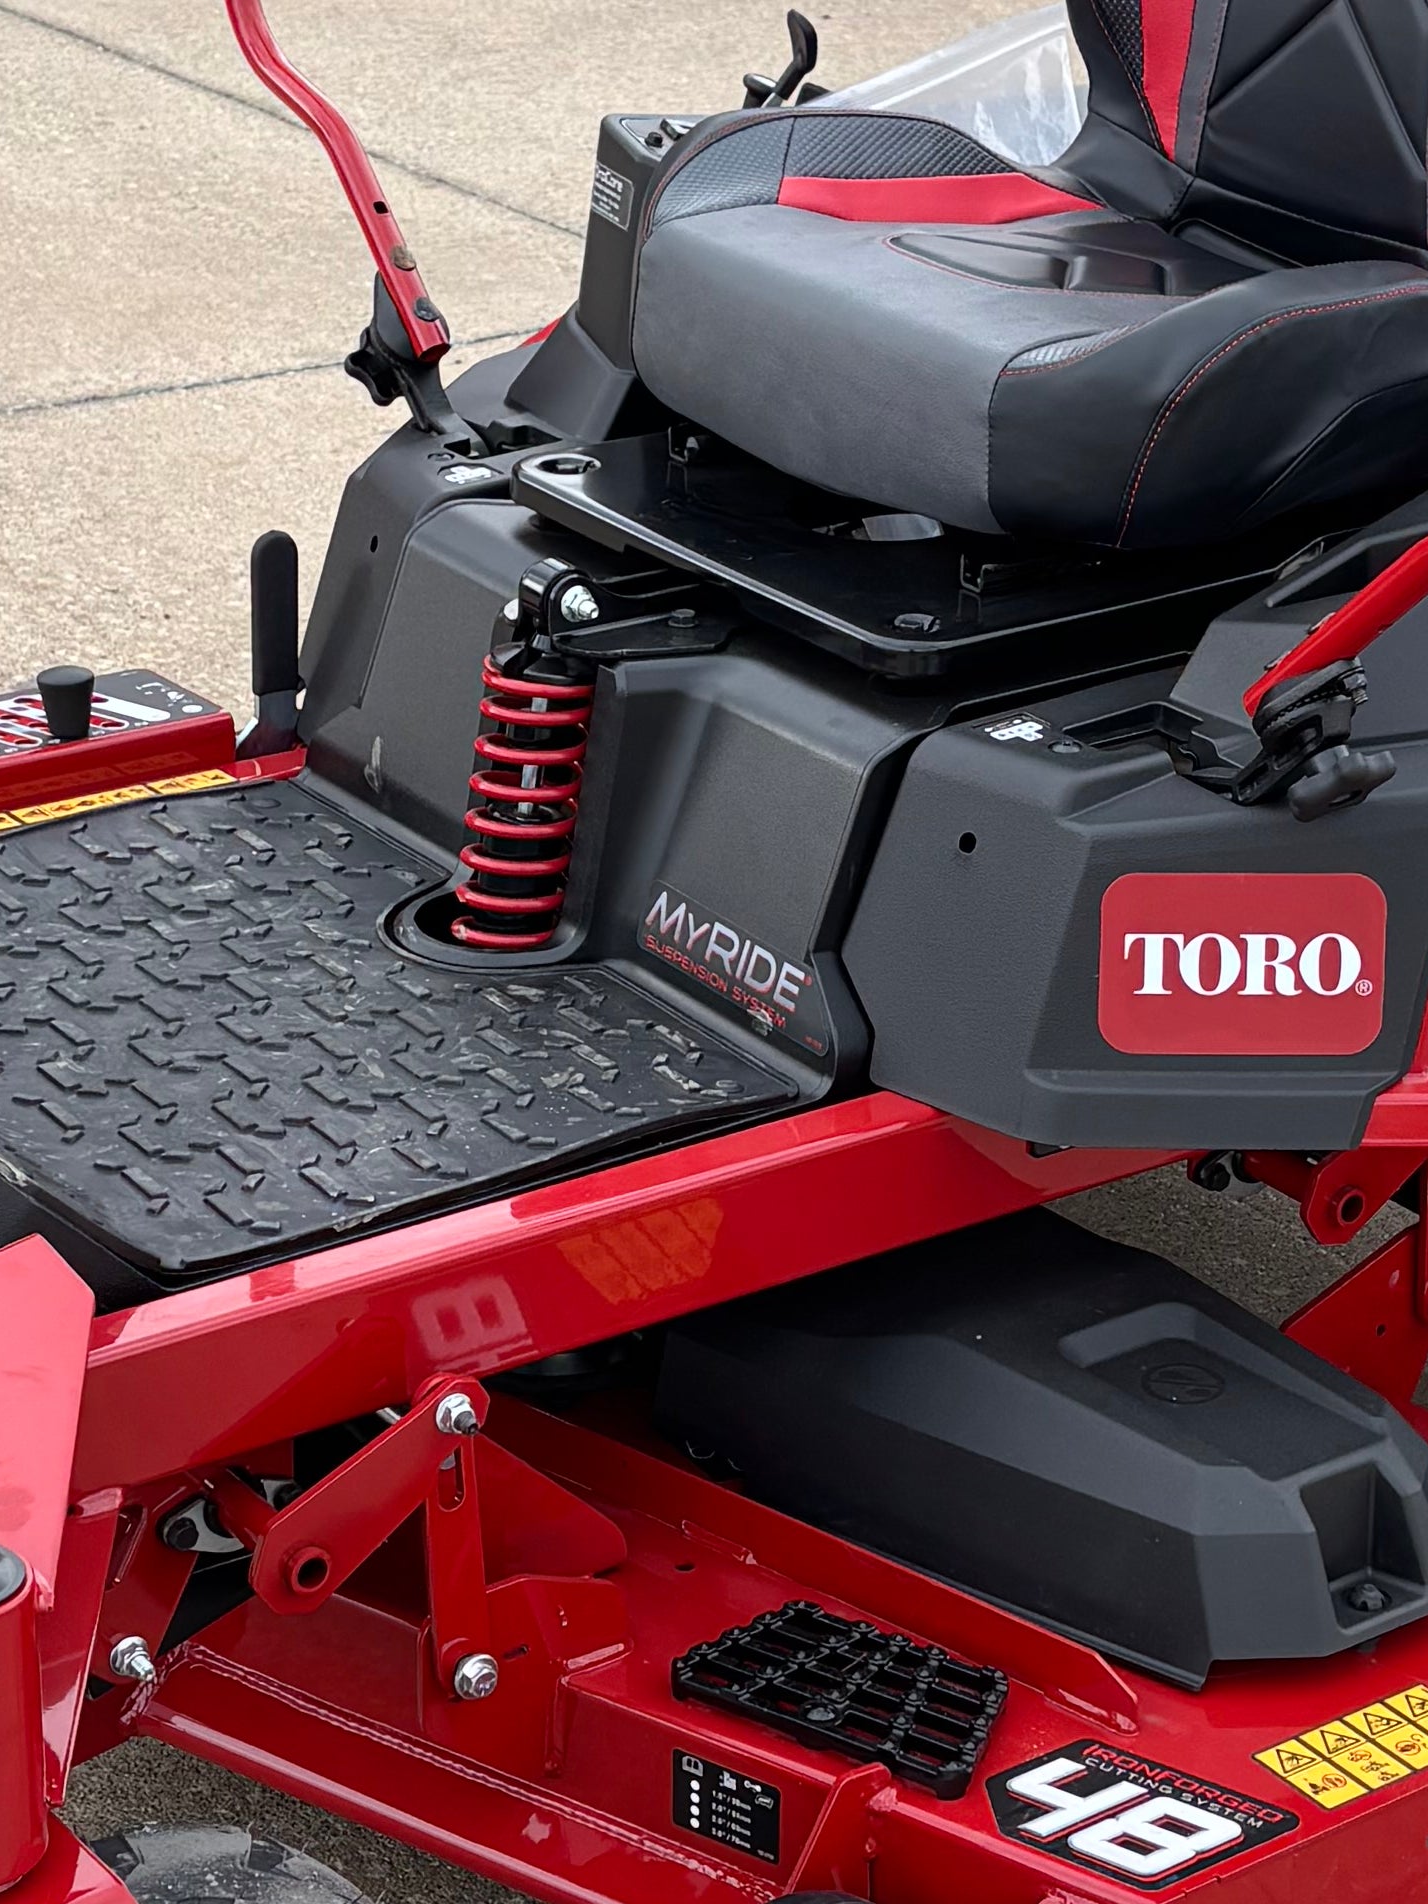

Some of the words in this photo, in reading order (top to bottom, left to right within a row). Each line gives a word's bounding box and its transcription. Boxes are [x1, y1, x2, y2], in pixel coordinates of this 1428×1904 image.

[644, 934, 728, 993] SUSPENSION
[1123, 932, 1362, 997] TORO
[1005, 1756, 1245, 1882] 48
[1080, 1743, 1285, 1824] IRONFORGED
[1084, 1756, 1174, 1795] CUTTING
[1180, 1791, 1264, 1830] SYSTEM
